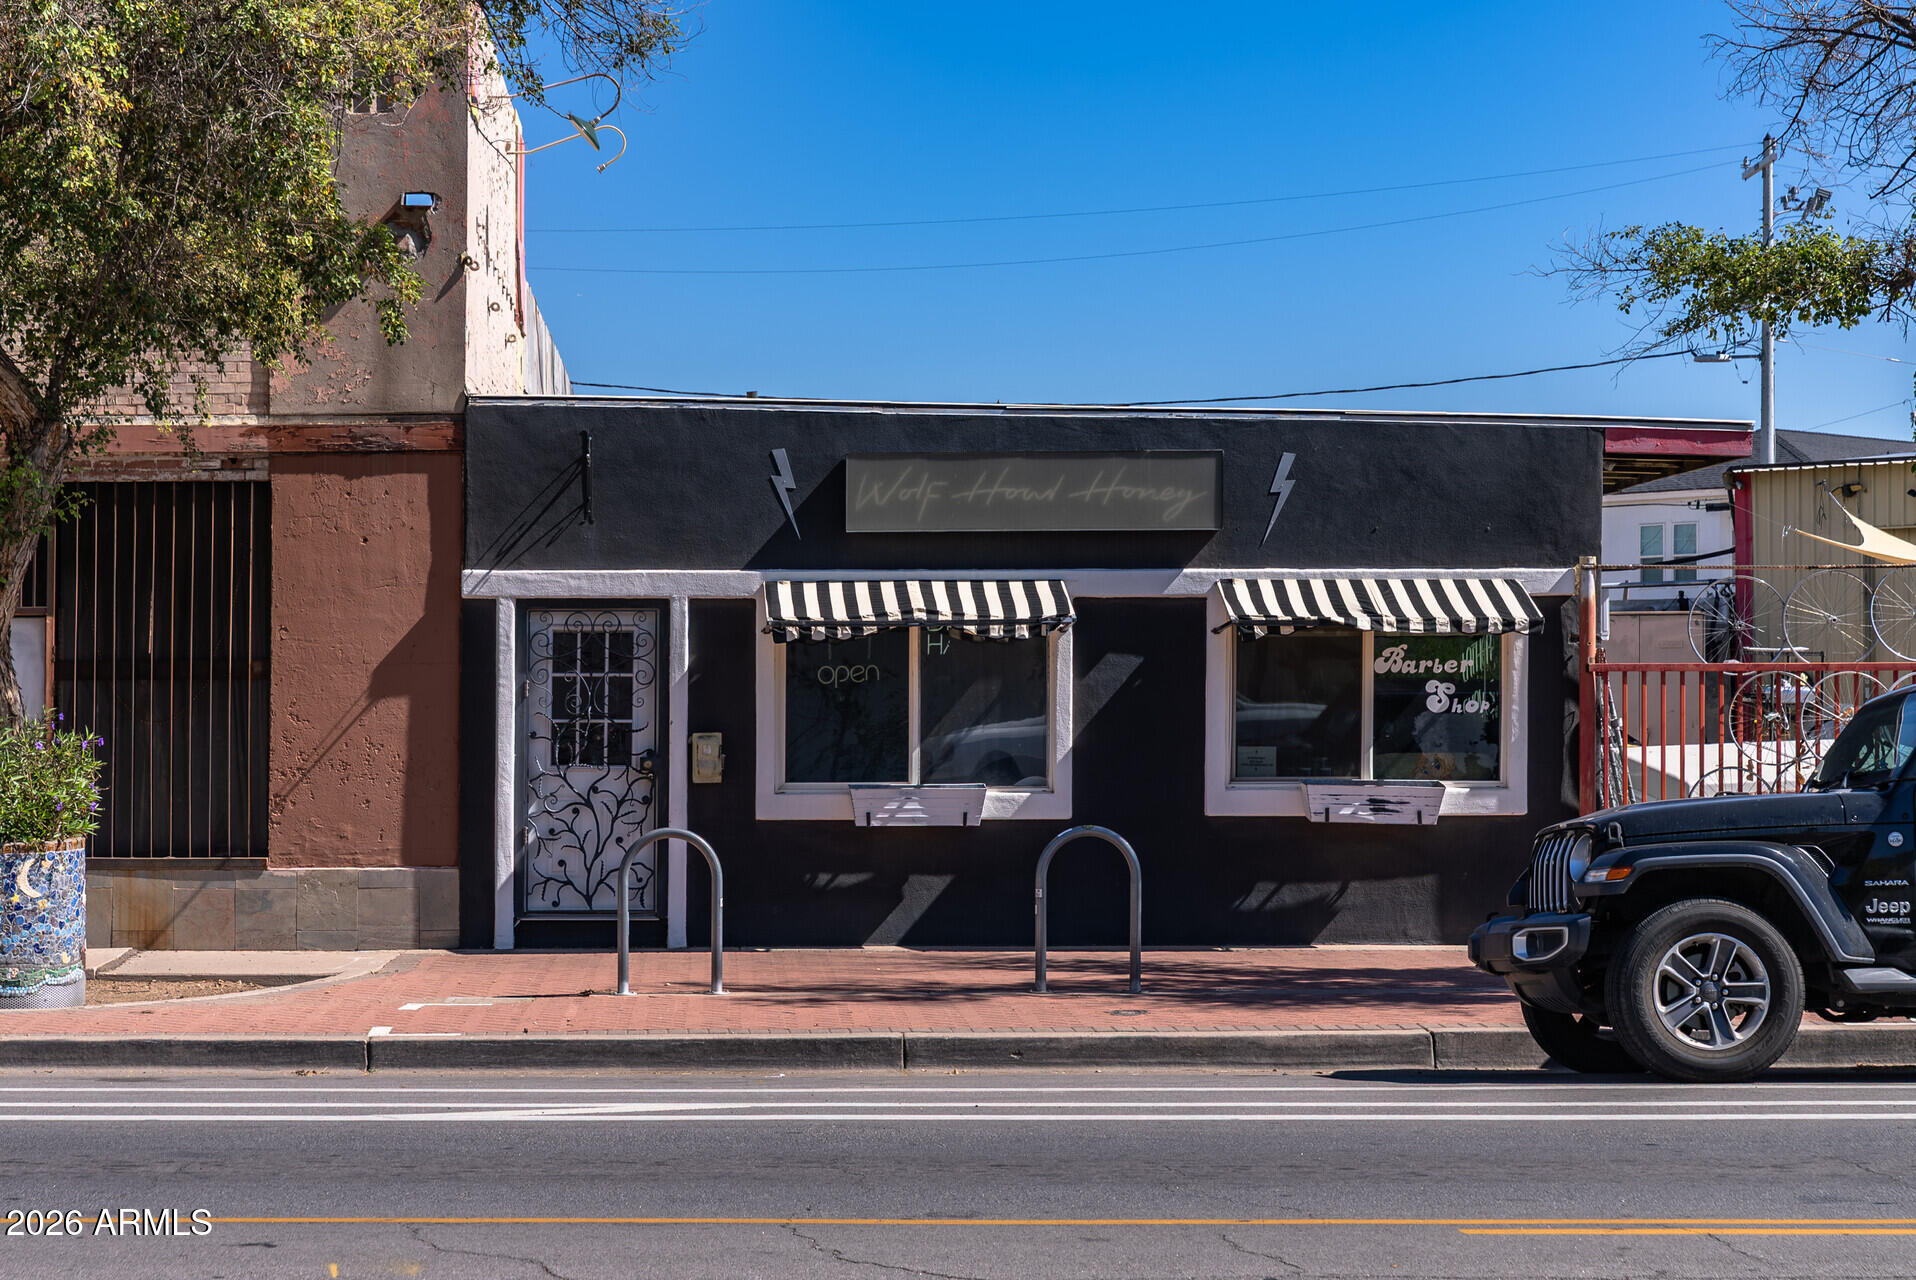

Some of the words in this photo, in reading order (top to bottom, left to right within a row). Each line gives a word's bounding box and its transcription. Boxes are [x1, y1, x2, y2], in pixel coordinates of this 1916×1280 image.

[1069, 465, 1208, 521] Honey
[1374, 644, 1474, 674] Barber
[817, 664, 880, 688] open
[1425, 679, 1491, 714] Shop
[1865, 898, 1911, 916] Jeep
